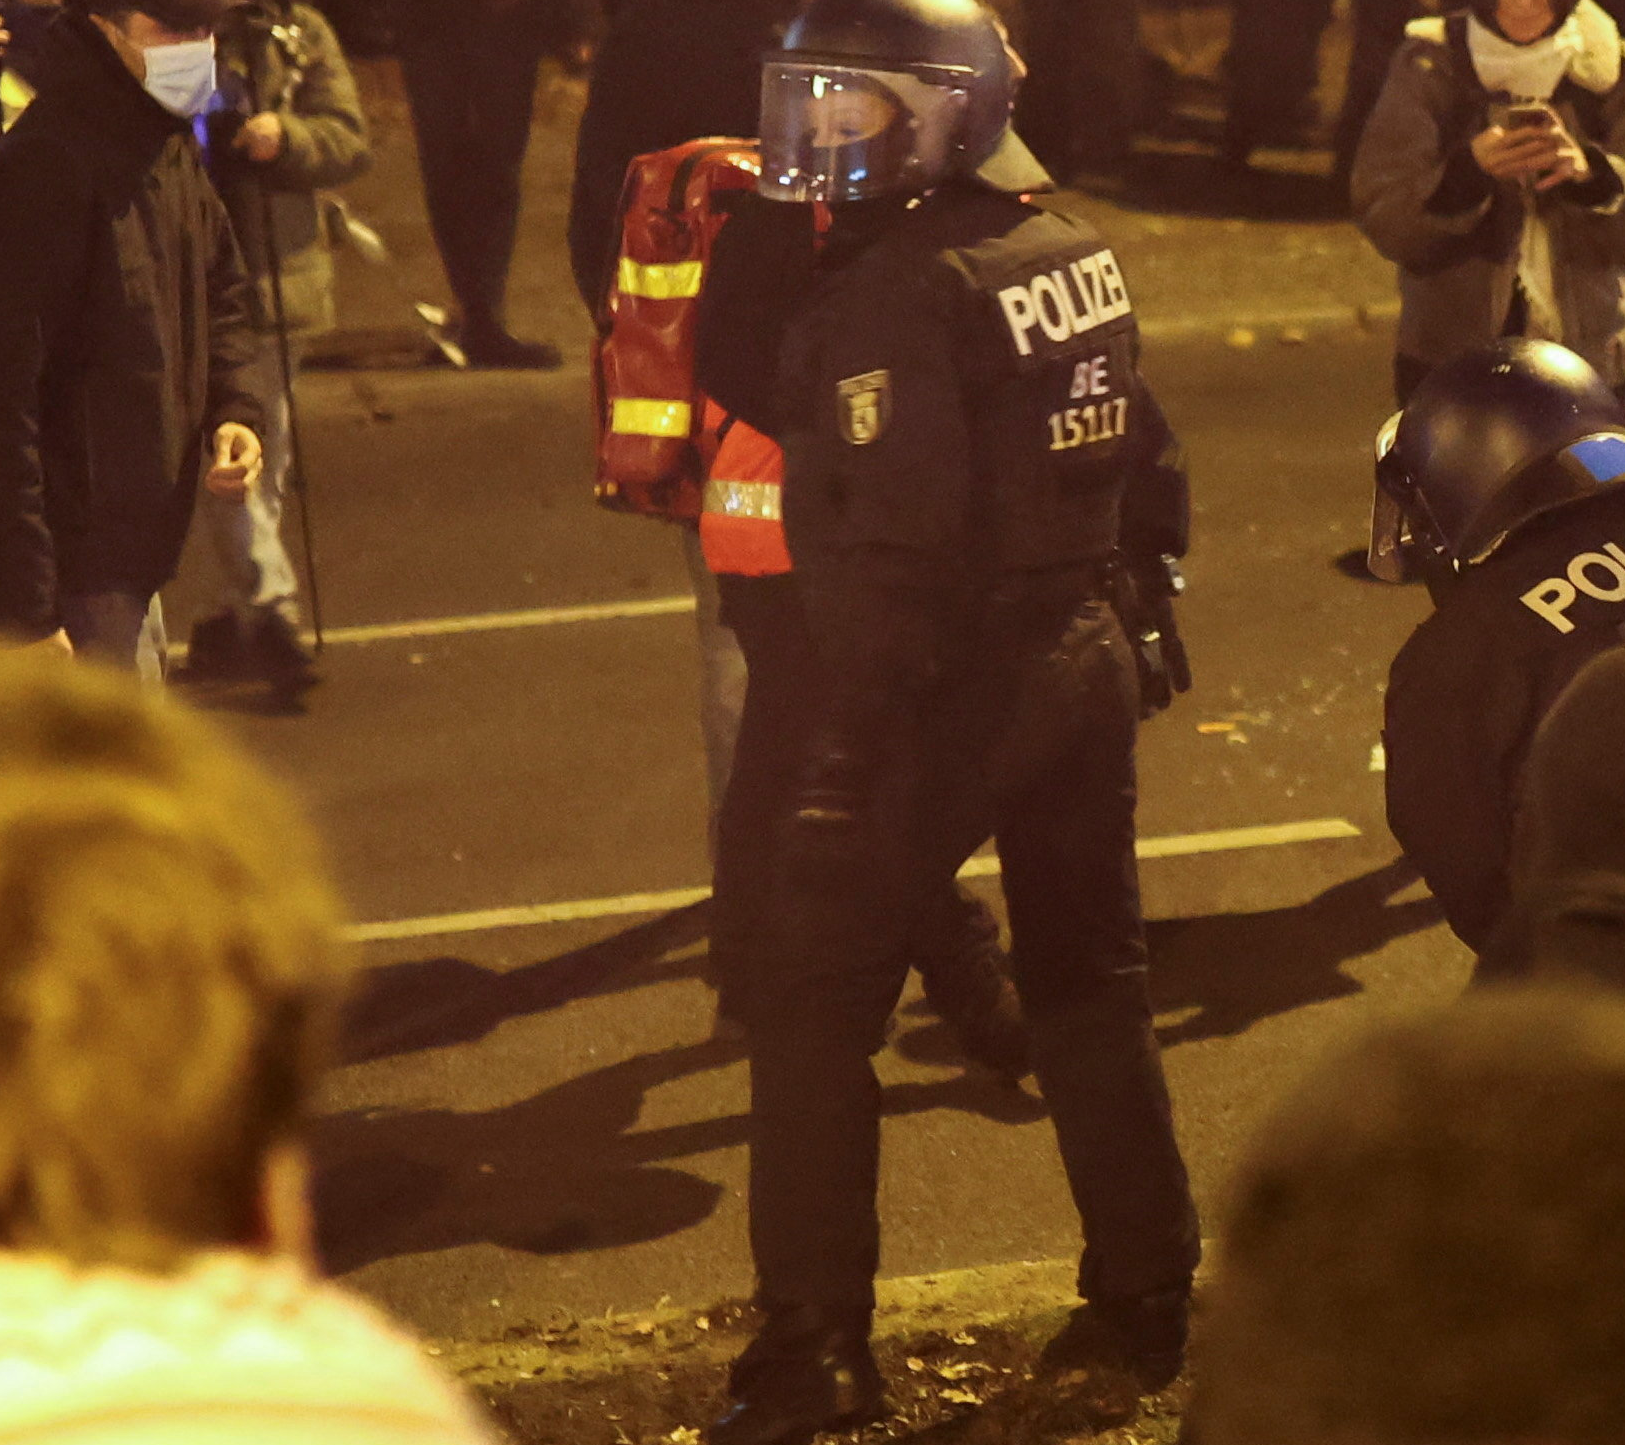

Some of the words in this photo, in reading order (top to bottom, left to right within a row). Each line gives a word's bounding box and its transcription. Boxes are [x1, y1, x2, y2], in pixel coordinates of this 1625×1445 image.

[998, 249, 1131, 356] POLIZEI
[1070, 356, 1110, 399] BE
[1048, 397, 1128, 451] 15117
